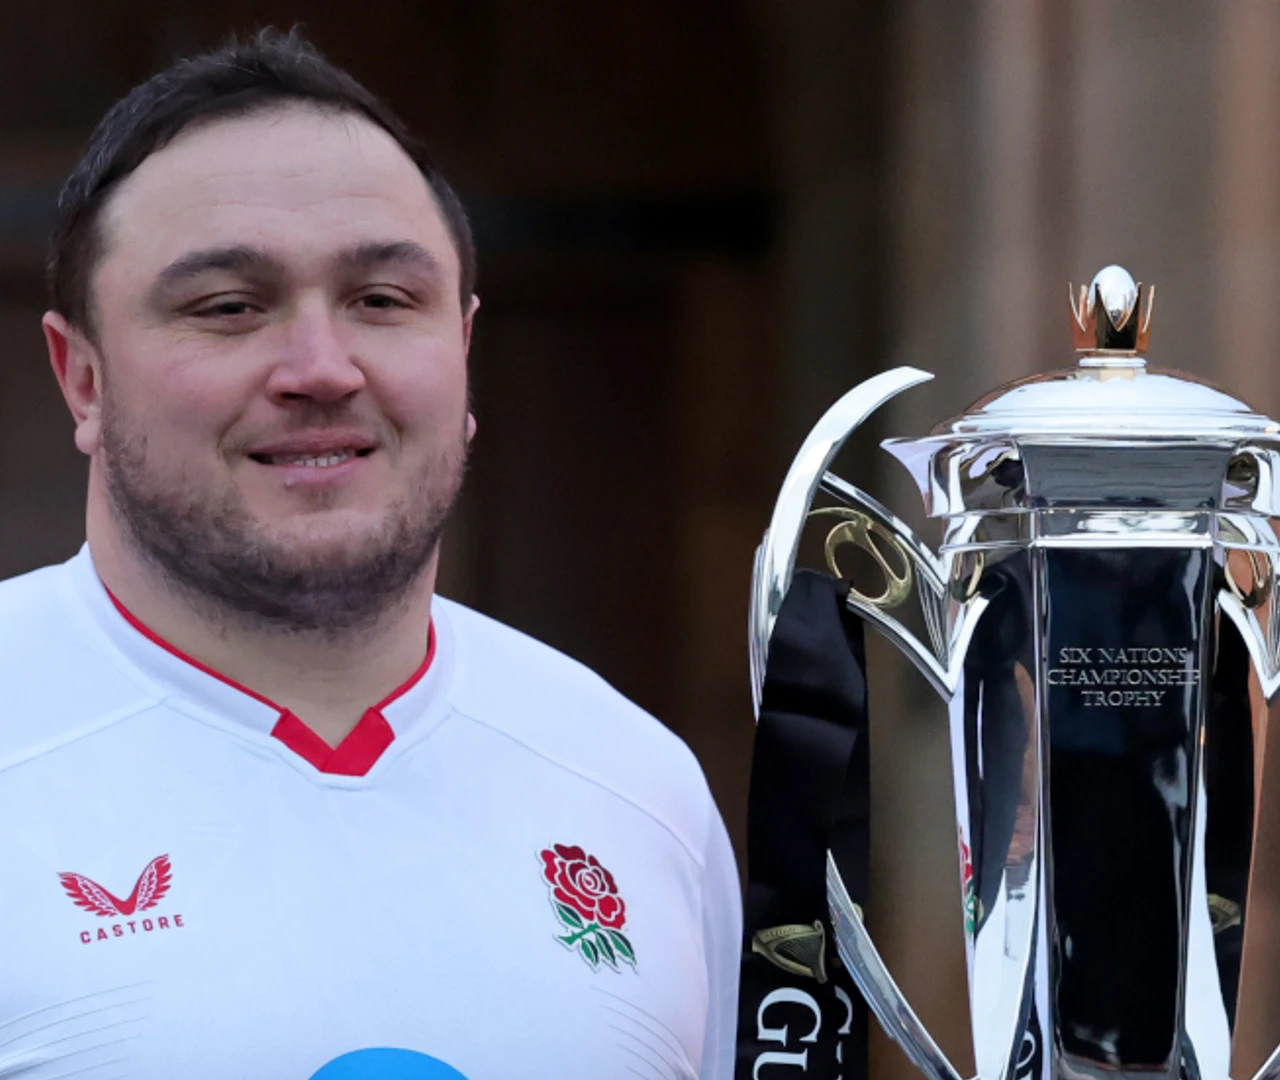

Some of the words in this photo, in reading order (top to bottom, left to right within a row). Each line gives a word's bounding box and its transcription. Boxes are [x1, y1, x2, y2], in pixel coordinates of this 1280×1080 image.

[1059, 648, 1092, 664] SIX
[1098, 648, 1189, 664] NATIONS
[1047, 669, 1201, 685] CHAMPIONSHIP
[1081, 691, 1166, 706] TROPHY
[79, 914, 185, 944] CASTORE
